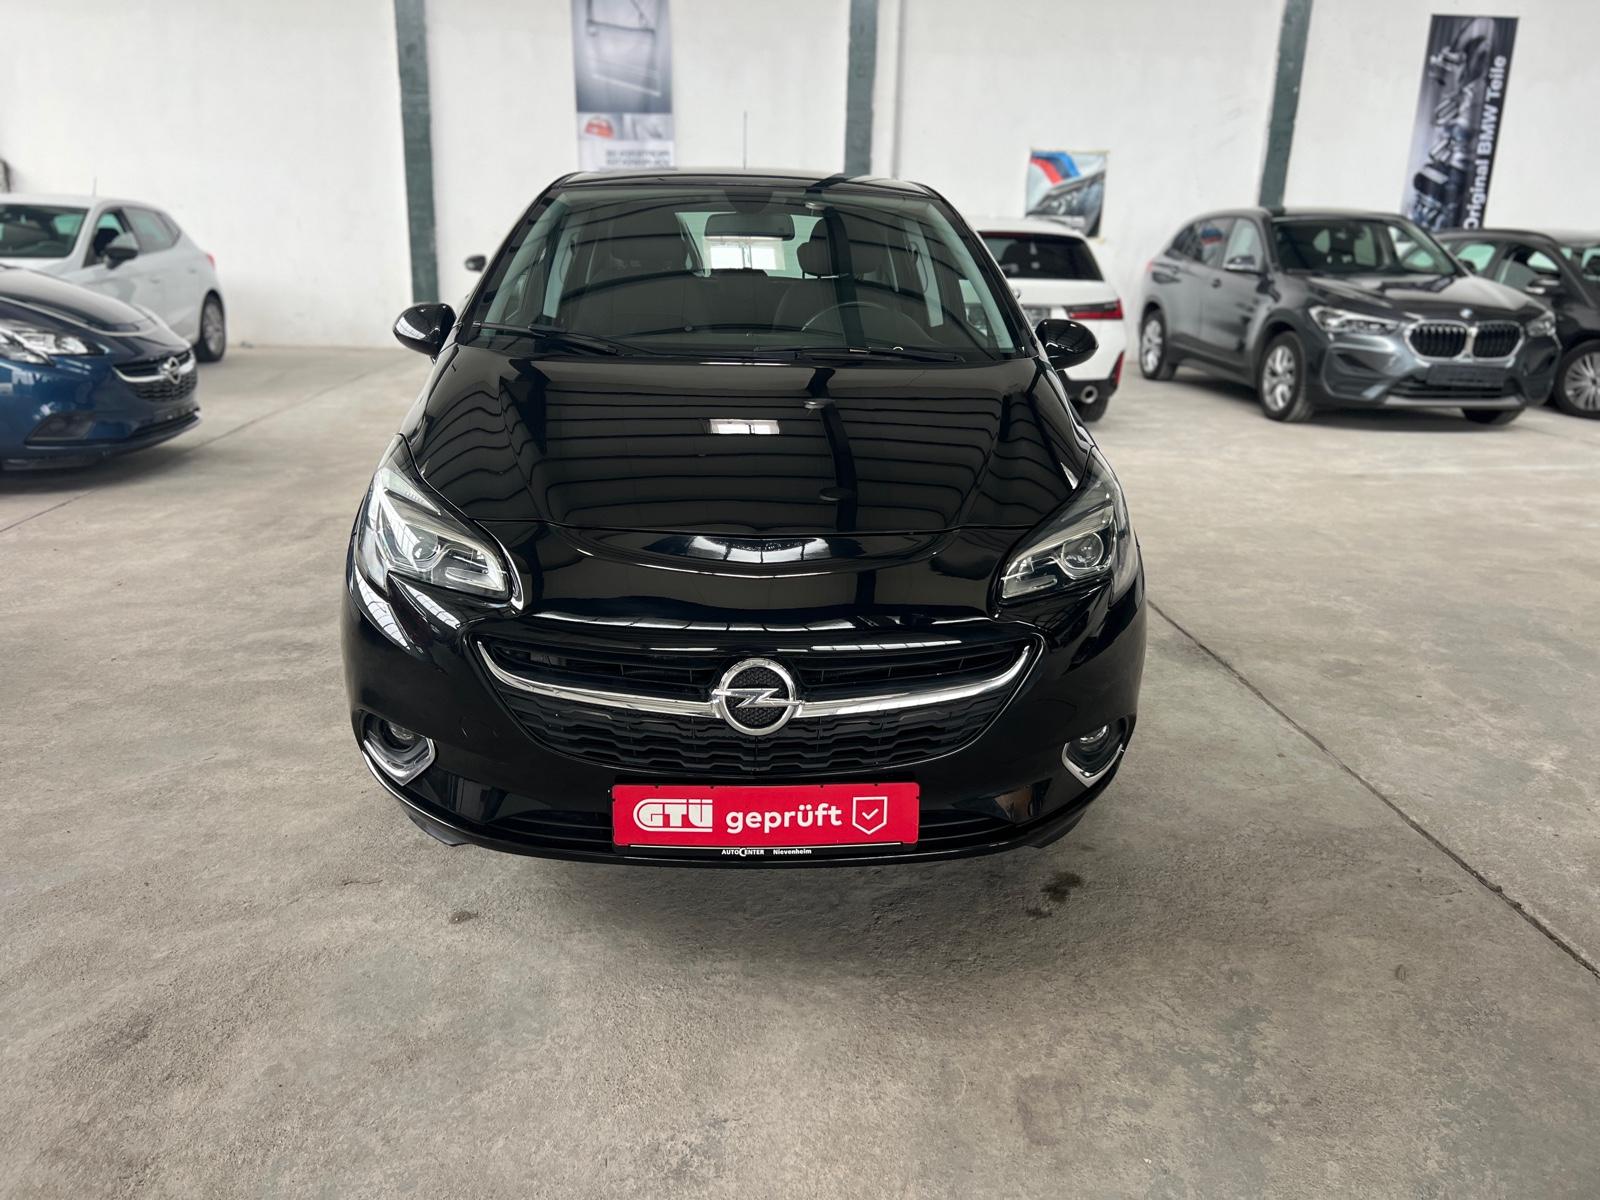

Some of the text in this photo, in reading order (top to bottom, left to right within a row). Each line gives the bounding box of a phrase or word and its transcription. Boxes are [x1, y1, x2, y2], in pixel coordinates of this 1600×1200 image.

[1463, 55, 1507, 230] Original BMW Teile
[633, 799, 843, 834] GTÜ geprüft
[773, 848, 812, 856] Nievenheim
